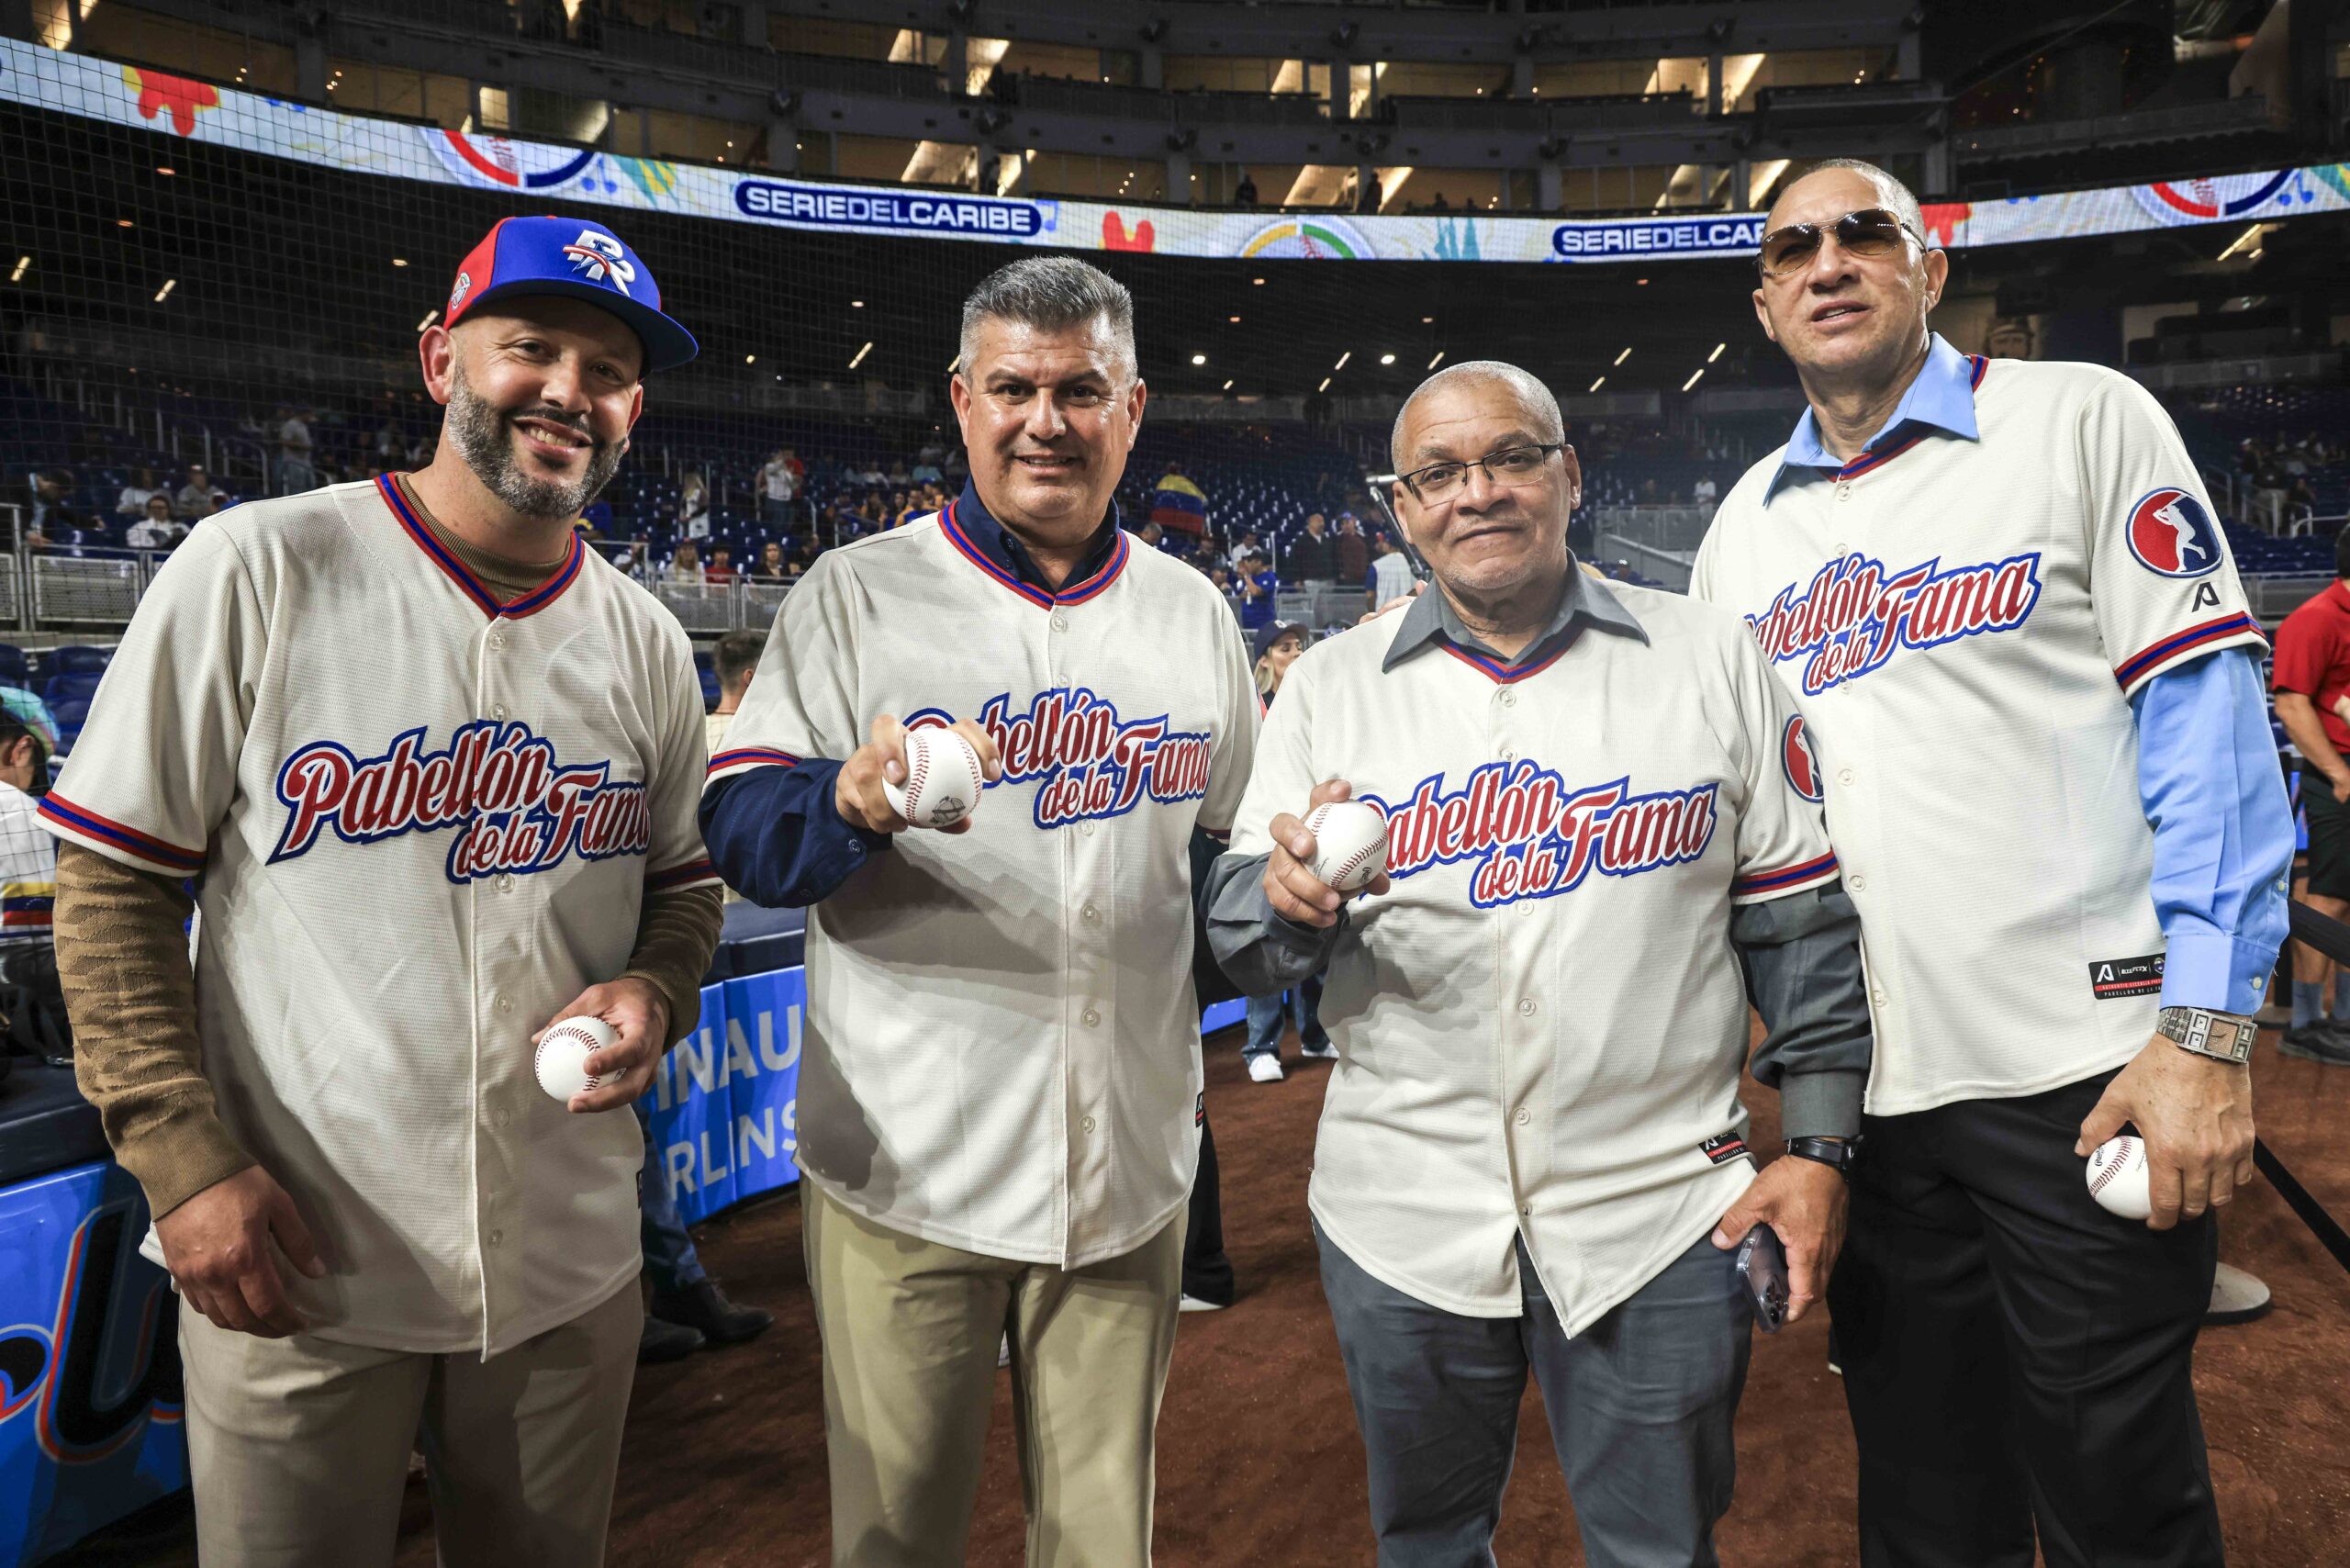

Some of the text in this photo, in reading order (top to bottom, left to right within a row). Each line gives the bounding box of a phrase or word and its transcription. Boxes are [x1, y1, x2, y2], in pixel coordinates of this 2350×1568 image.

[746, 186, 1031, 232] SERIEDELCARIBE
[1561, 222, 1765, 253] SERIEDELCA
[1747, 558, 1879, 662] abellón
[1871, 558, 2036, 664] Fama
[904, 691, 1118, 782] bellón
[276, 723, 554, 859] Pabellón
[1365, 764, 1563, 875] abellón
[1554, 782, 1715, 890] Fama
[657, 1004, 802, 1112] INAU
[666, 1100, 798, 1201] RLINS
